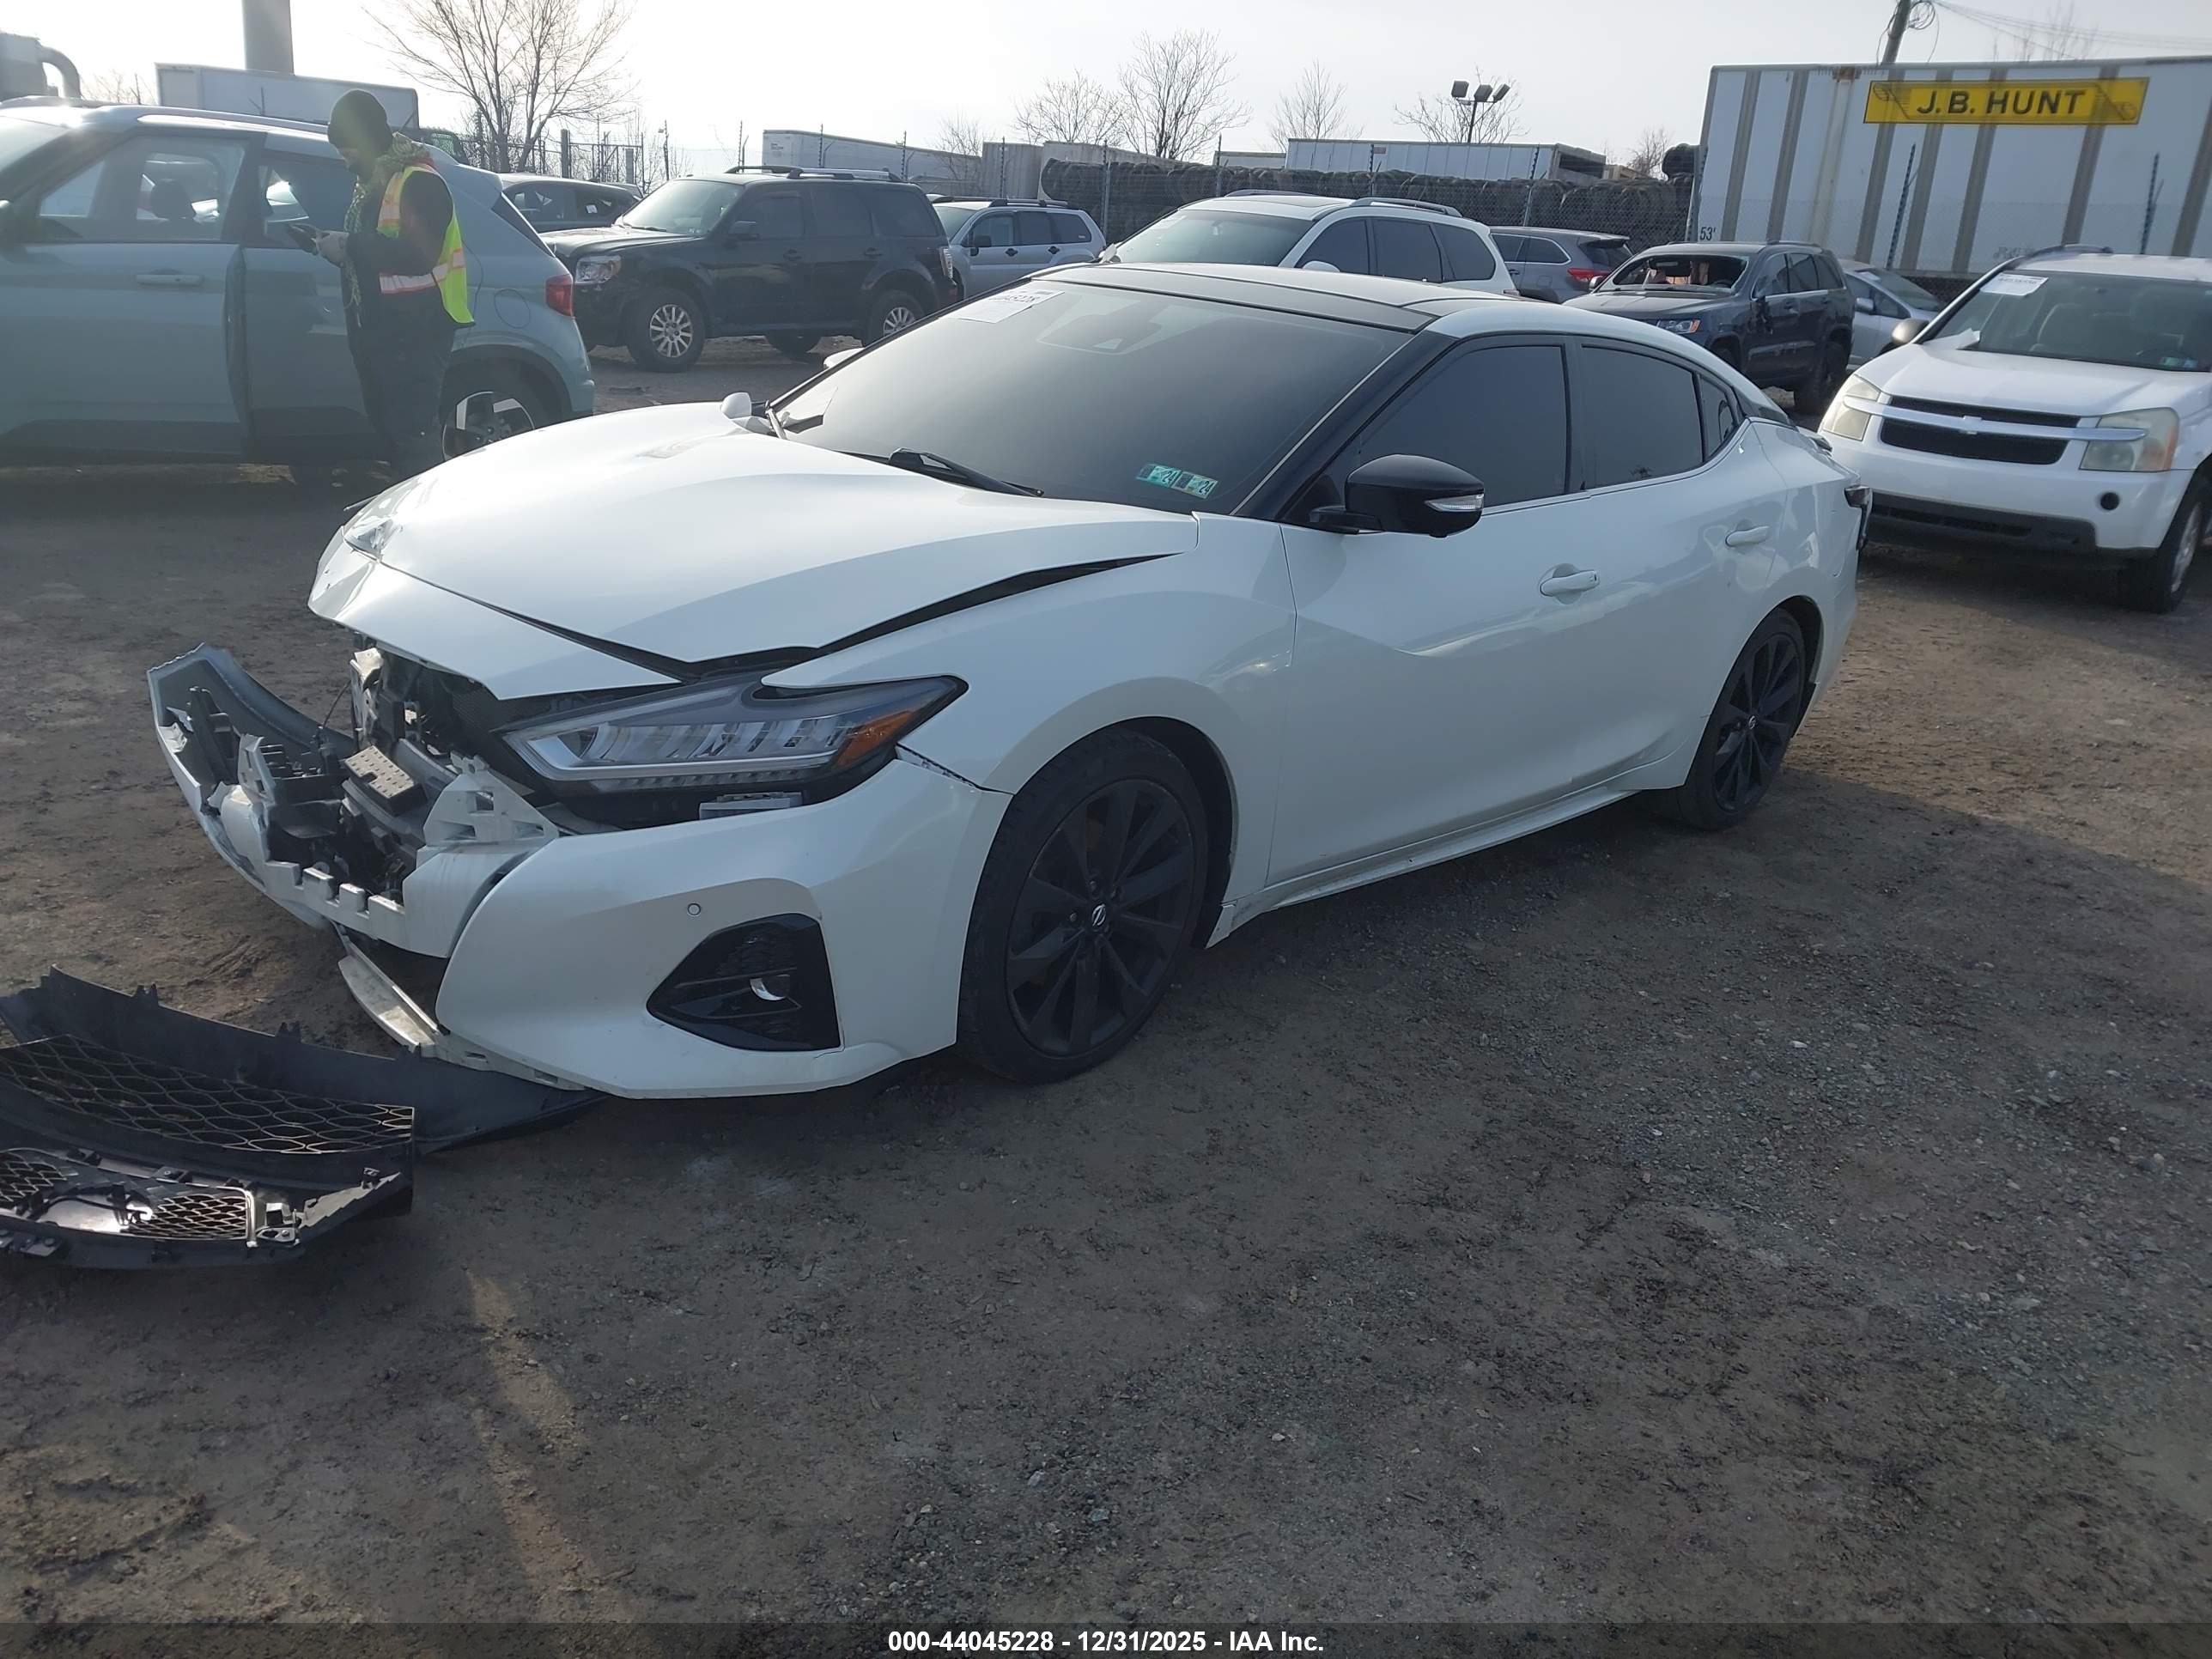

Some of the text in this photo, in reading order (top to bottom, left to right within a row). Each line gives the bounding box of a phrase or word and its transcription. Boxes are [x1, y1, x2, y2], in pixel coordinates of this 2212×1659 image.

[1984, 89, 2086, 114] HUNT
[1700, 226, 1717, 241] 53'
[1162, 470, 1179, 483] 24
[1198, 480, 1216, 495] 24
